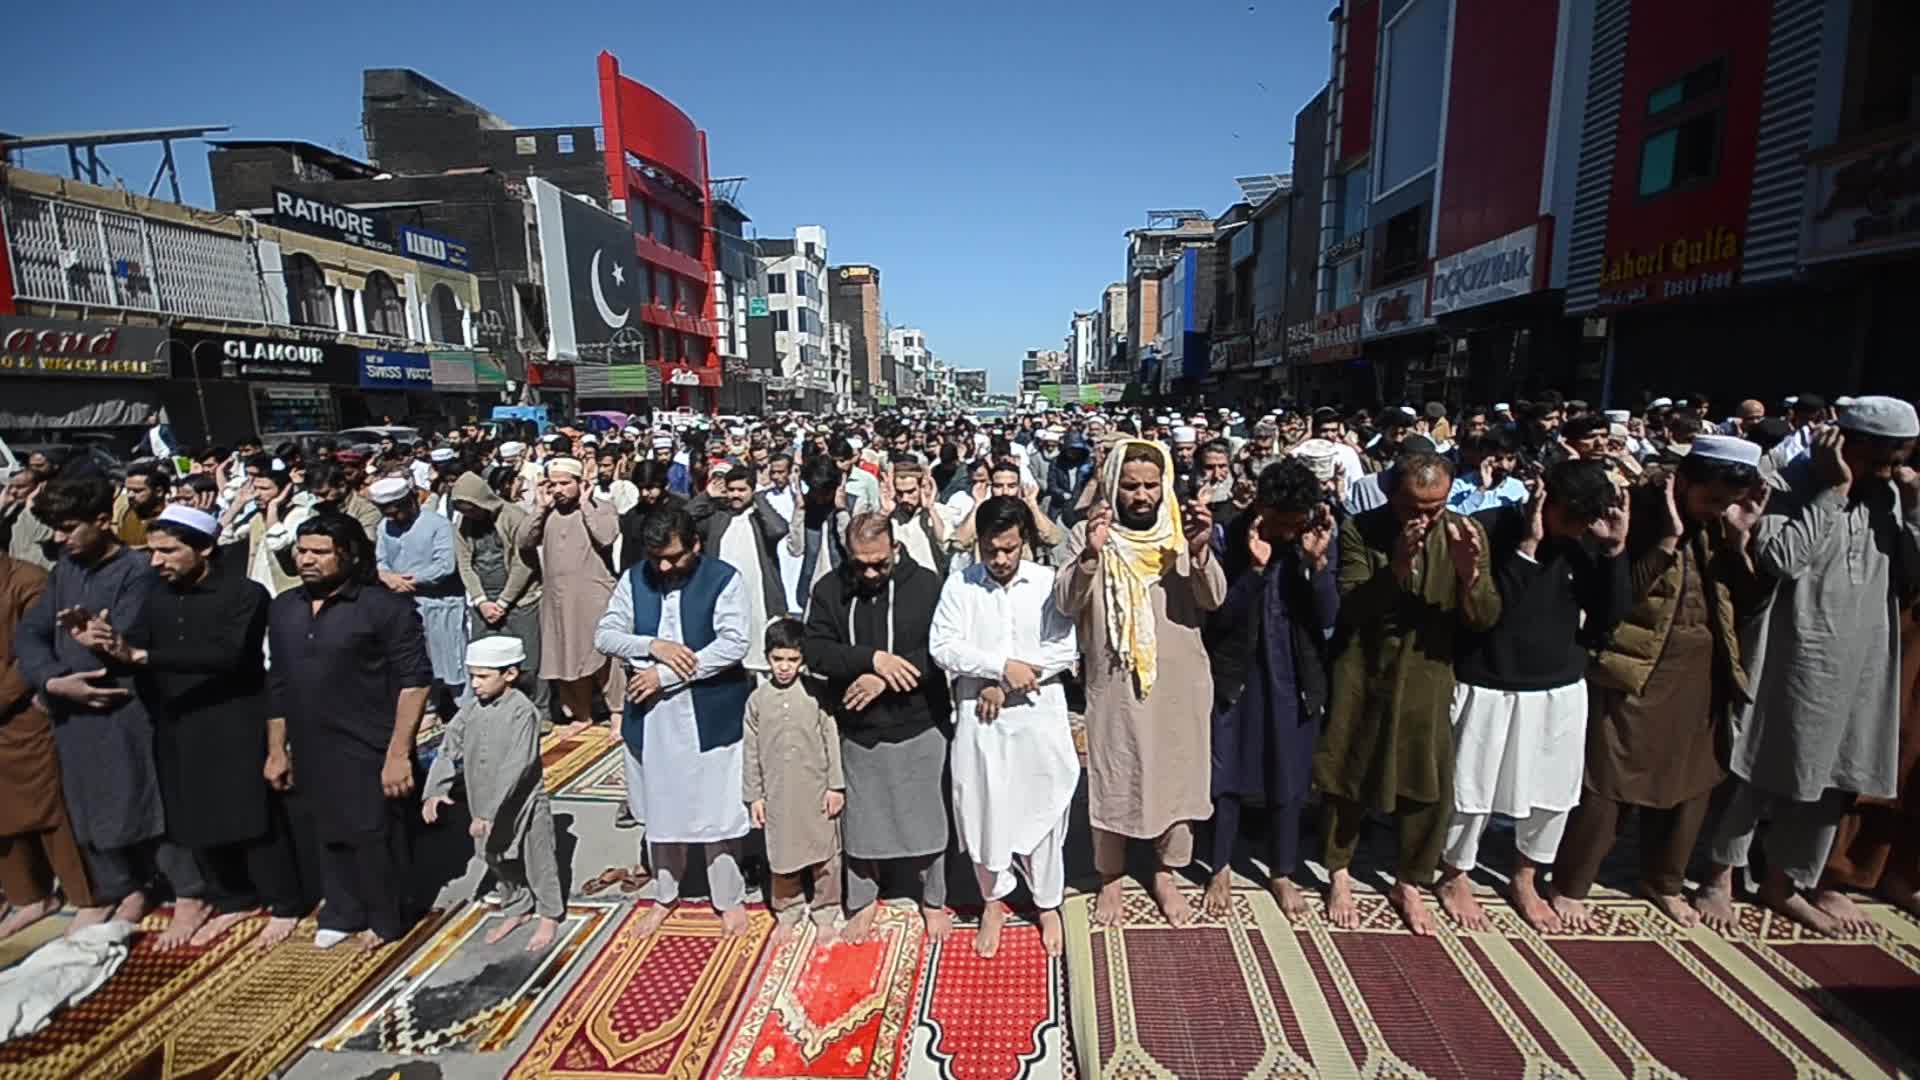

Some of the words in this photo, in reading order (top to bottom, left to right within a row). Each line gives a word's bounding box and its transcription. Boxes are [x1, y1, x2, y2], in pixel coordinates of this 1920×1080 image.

[277, 192, 375, 237] RATHORE
[223, 339, 324, 363] GLAMOUR
[366, 365, 402, 379] SWISS
